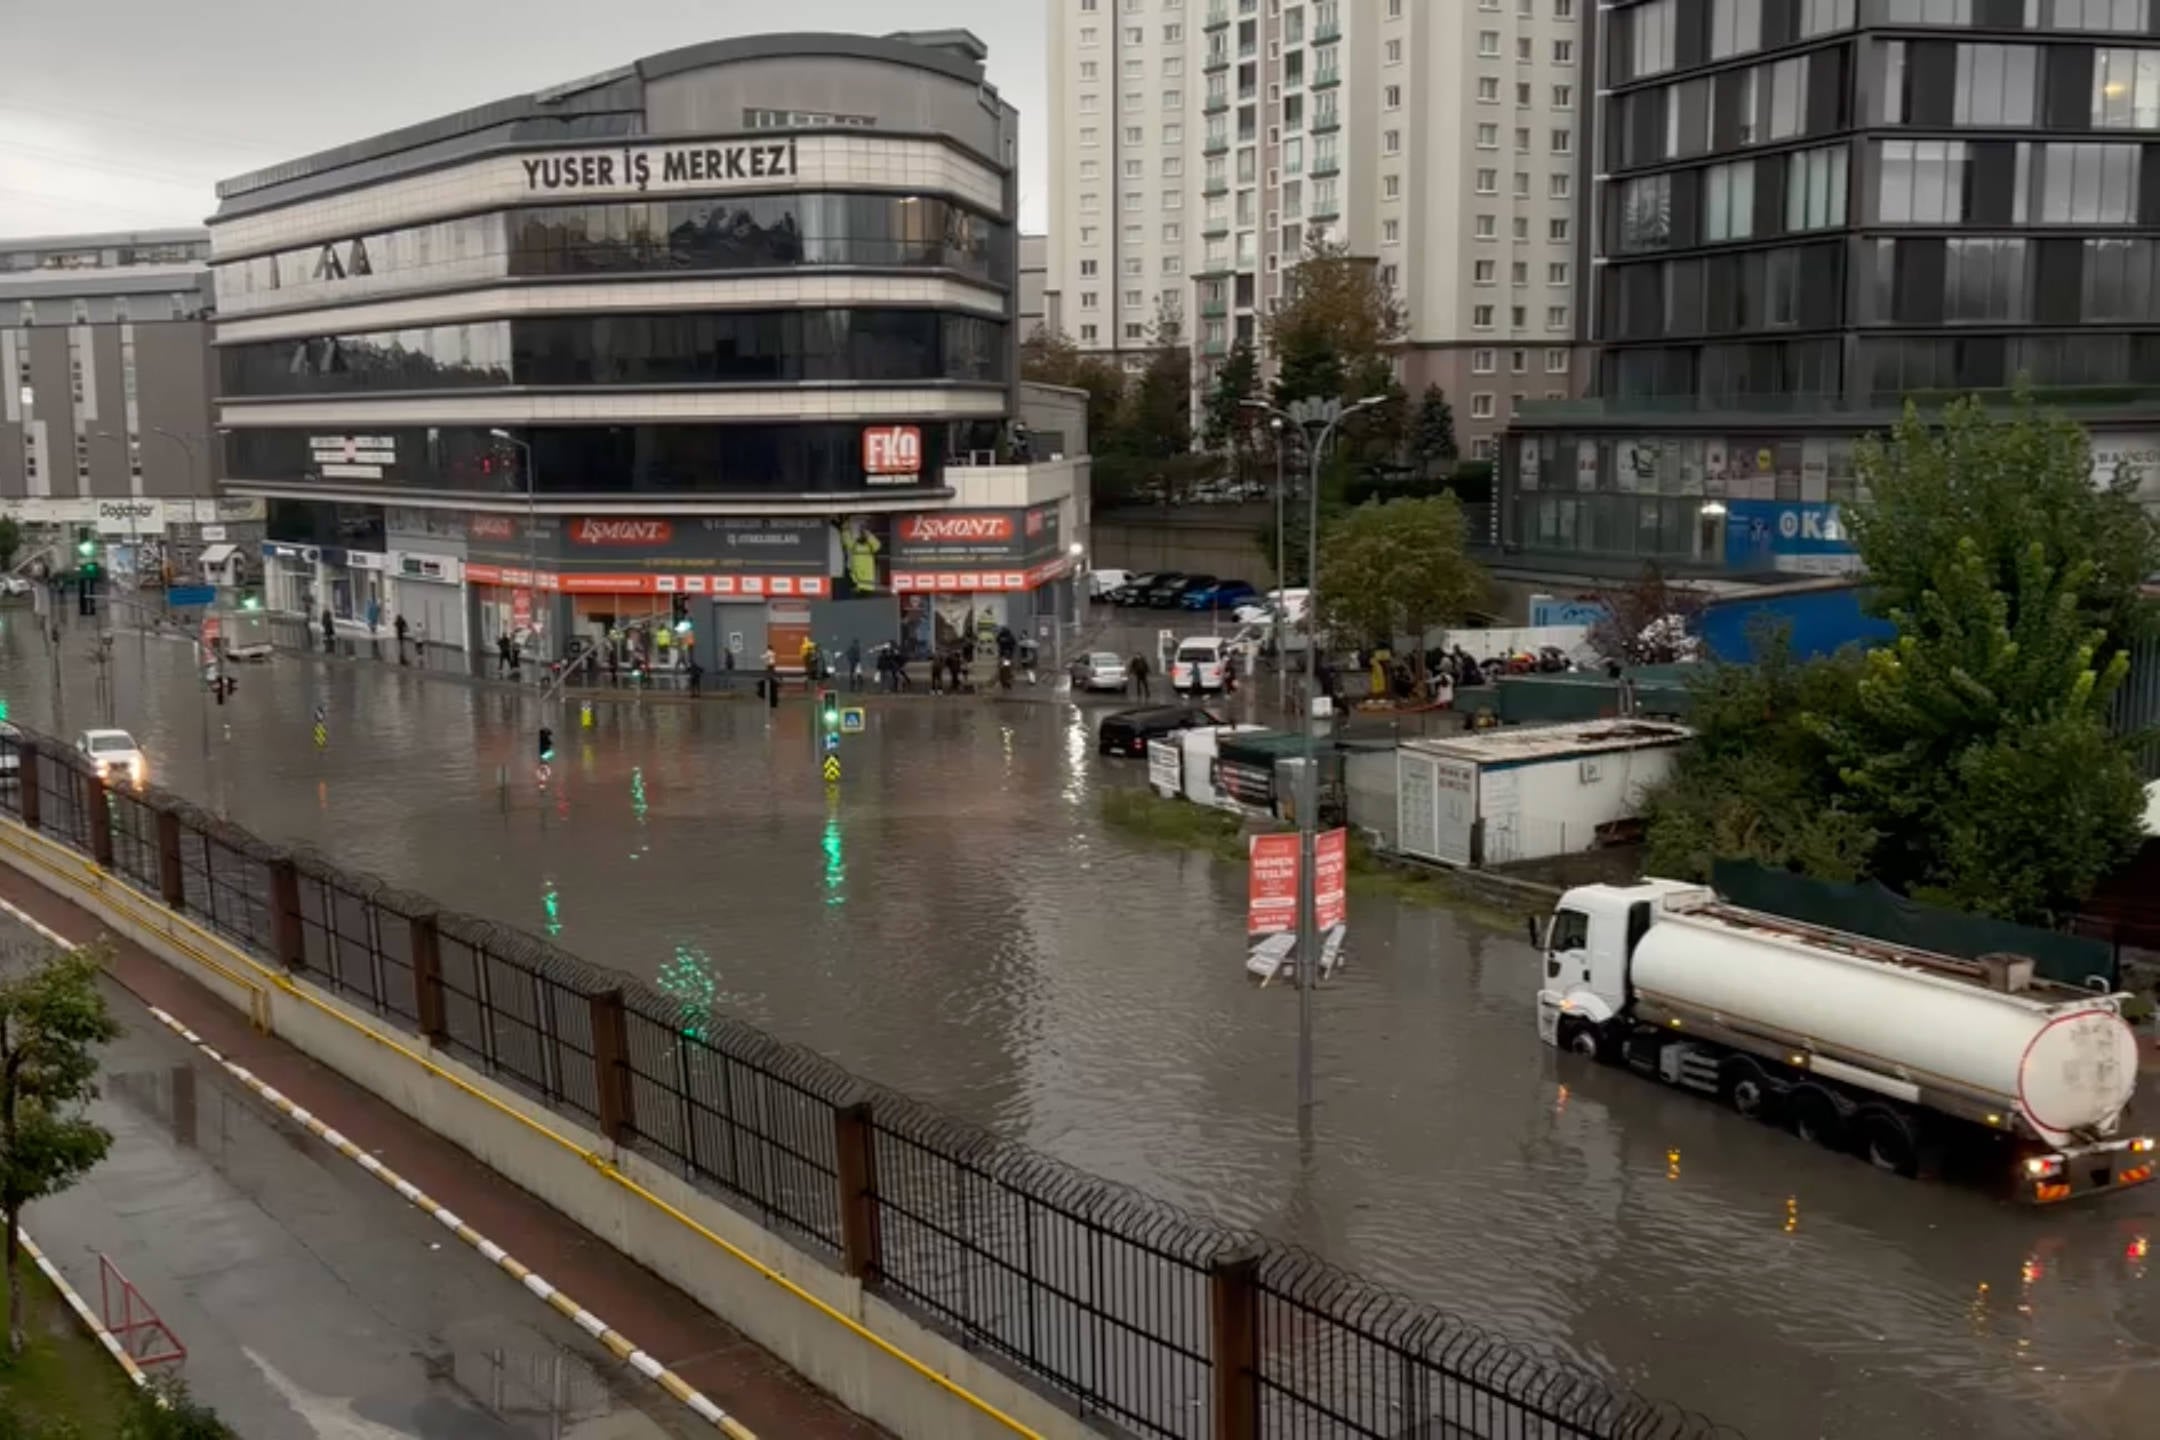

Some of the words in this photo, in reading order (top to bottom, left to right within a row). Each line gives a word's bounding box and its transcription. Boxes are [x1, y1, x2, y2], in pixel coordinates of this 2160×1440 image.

[522, 156, 614, 190] YUSER
[624, 147, 650, 191] İŞ
[662, 137, 797, 183] MERKEZİ
[580, 517, 662, 543] İŞMONT
[911, 514, 1004, 541] İŞMONT
